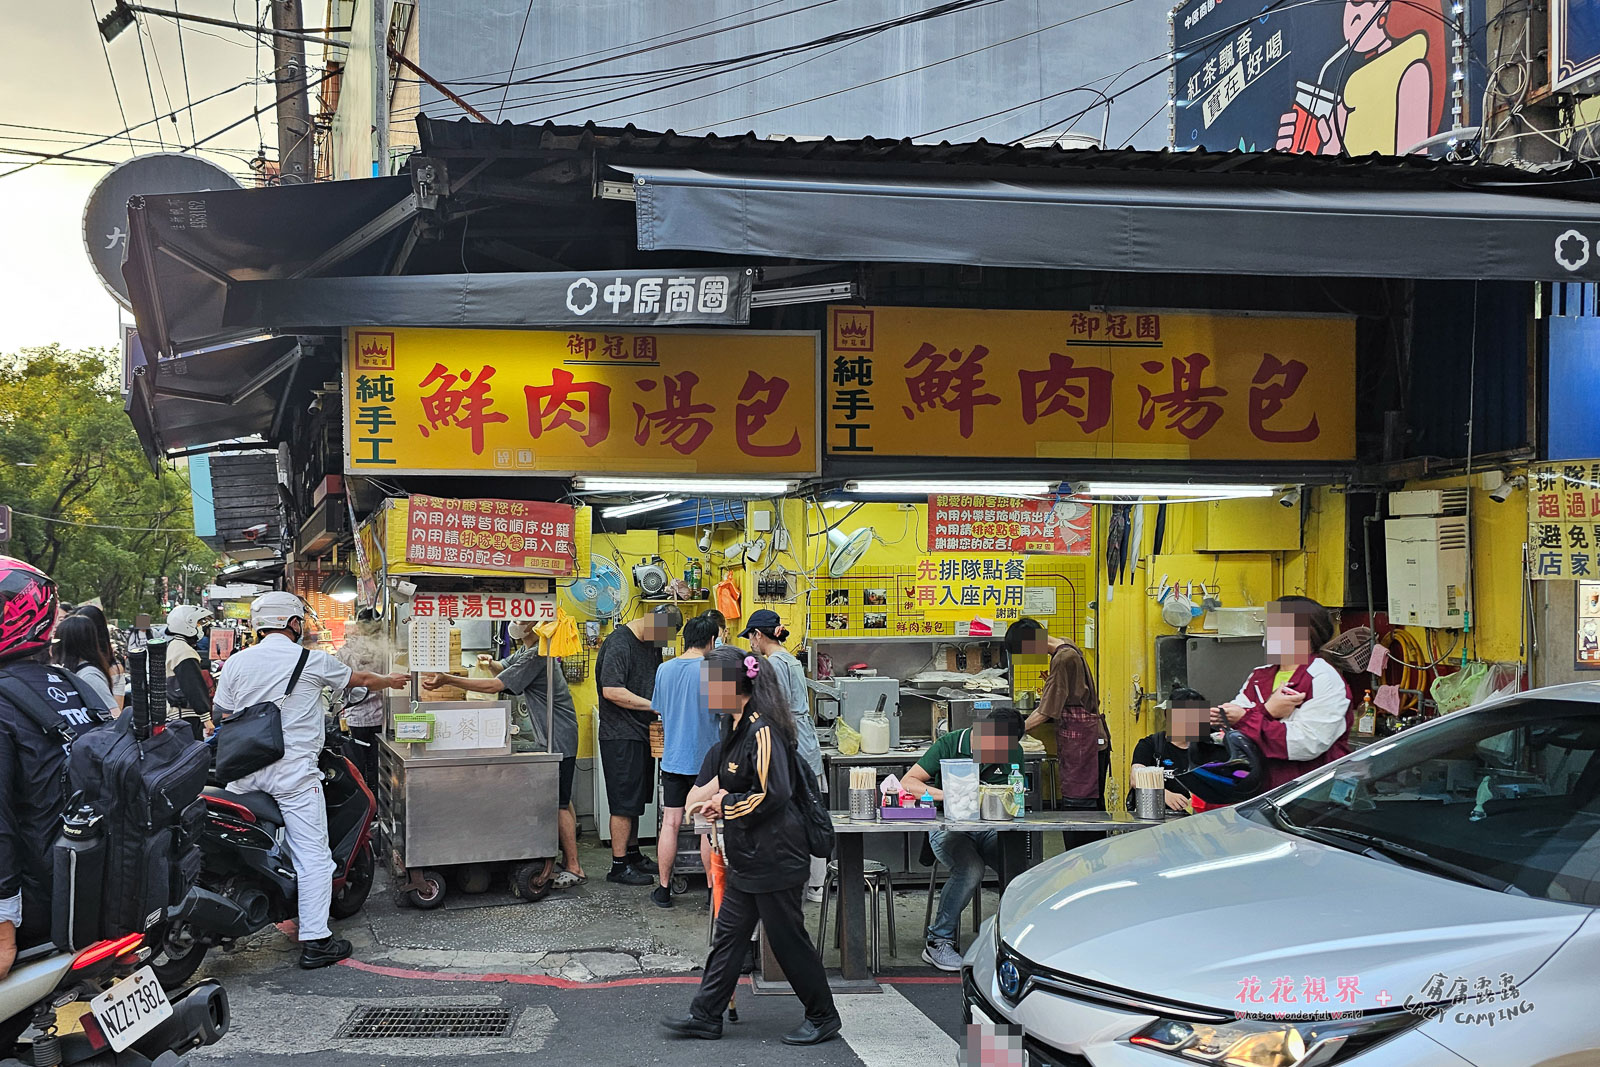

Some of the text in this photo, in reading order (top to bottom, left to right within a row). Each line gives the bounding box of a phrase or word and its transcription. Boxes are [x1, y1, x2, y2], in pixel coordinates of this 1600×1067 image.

[1187, 27, 1253, 101] 紅茶飄香
[602, 276, 730, 315] 中原商圈
[1070, 313, 1161, 340] 御冠園
[567, 333, 659, 362] 御冠園
[832, 355, 874, 452] 純手工
[901, 342, 1321, 443] 鮮肉湯包
[355, 374, 397, 465] 純手工
[417, 362, 802, 458] 鮮肉湯包
[411, 527, 569, 554] 內用請排隊點餐再入座
[410, 543, 511, 566] 謝謝您的配合!
[917, 559, 1025, 581] 先排隊點餐
[412, 594, 554, 619] 每籠湯包80元
[916, 585, 1023, 606] 再入座內用
[896, 621, 945, 633] 鮮肉湯包
[995, 608, 1018, 619] 謝謝
